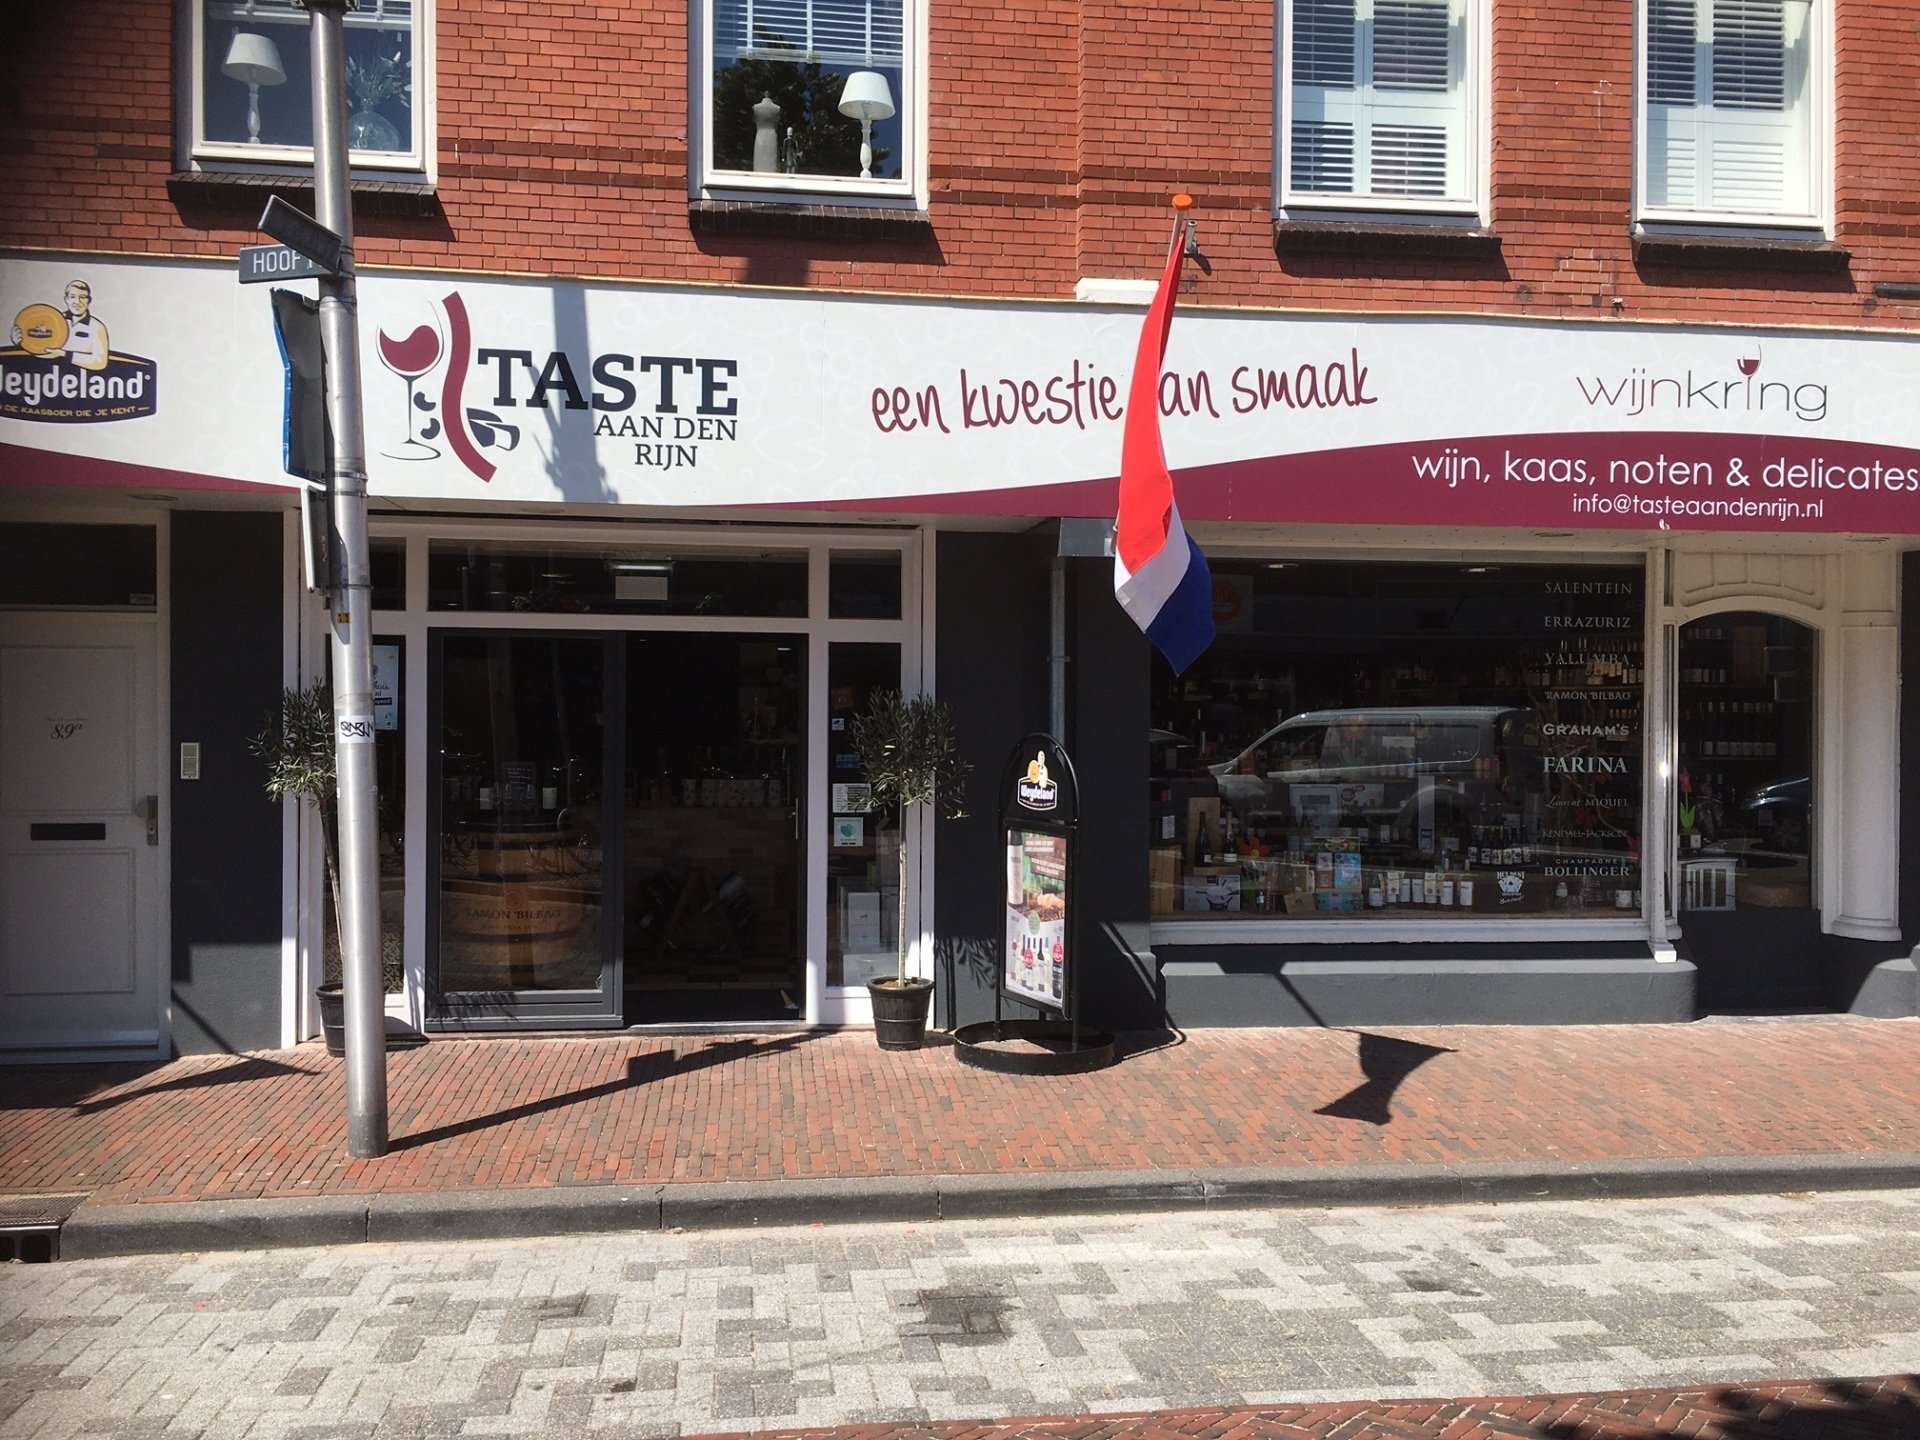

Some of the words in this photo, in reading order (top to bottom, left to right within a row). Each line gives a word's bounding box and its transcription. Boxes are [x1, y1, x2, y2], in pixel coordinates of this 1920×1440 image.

[0, 364, 144, 406] eydeland
[478, 348, 738, 416] TASTE
[872, 384, 951, 434] een
[960, 359, 1124, 430] kwestie
[1158, 370, 1220, 418] an
[1231, 347, 1378, 414] smaak
[1576, 364, 1827, 422] wijnkring
[5, 404, 18, 412] DE
[21, 406, 73, 416] KAASBOER
[76, 409, 92, 417] DIE
[95, 408, 108, 416] JE
[111, 405, 136, 415] KENT
[594, 414, 664, 438] AAN
[674, 418, 738, 441] DEN
[635, 444, 698, 471] RIJN
[1412, 448, 1491, 488] wijn,
[1504, 449, 1596, 486] kaas,
[1609, 453, 1713, 486] noten
[1726, 457, 1751, 487] &
[1572, 492, 1824, 522] info@tasteaandenrijn.nl
[1545, 581, 1632, 595] SALENTEIN
[1544, 616, 1631, 628] ERRAZURIZ
[1590, 691, 1631, 701] BILBAO
[1543, 722, 1630, 736] GRAHAM'S
[1543, 756, 1629, 773] FARINA
[1543, 828, 1627, 838] KENDALL-JACKSON
[1544, 866, 1630, 876] BOLLINGER
